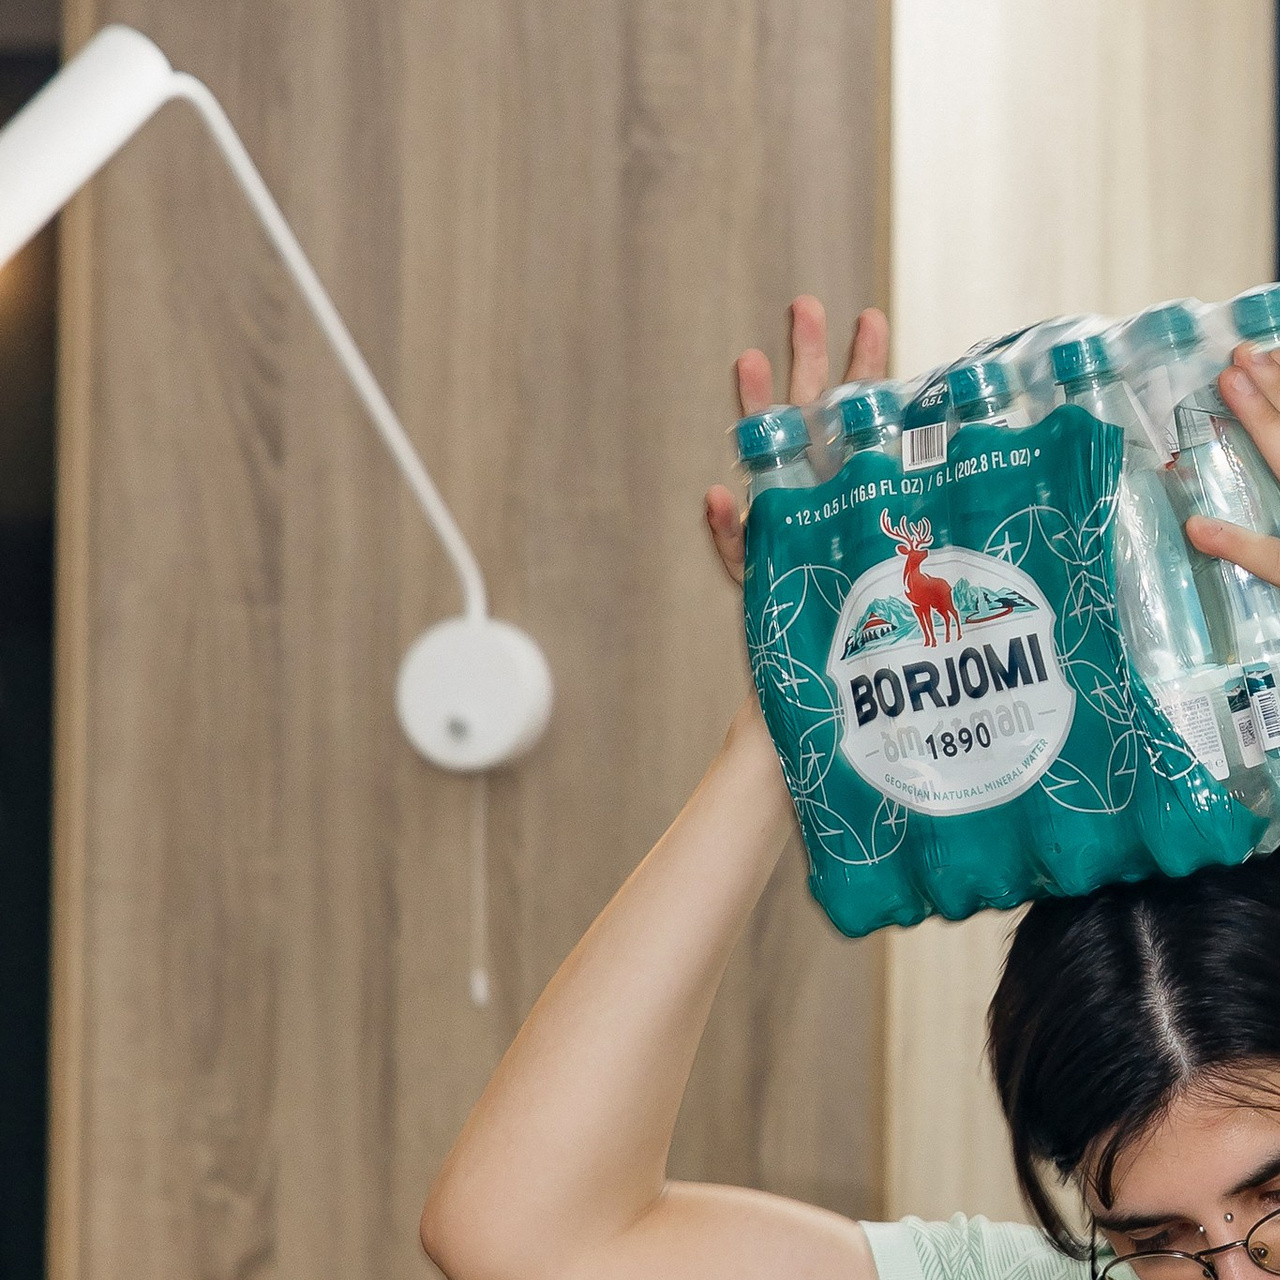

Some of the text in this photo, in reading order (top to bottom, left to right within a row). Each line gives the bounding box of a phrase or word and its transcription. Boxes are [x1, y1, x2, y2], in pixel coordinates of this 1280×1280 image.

[921, 394, 944, 408] 0.5 L
[796, 509, 811, 526] 12
[814, 510, 821, 522] x
[823, 498, 840, 519] 0.5
[842, 493, 848, 510] L
[850, 482, 877, 508] (16.9
[880, 479, 898, 496] FL
[901, 477, 924, 495] OZ)
[927, 474, 933, 492] /
[936, 470, 943, 487] 6
[946, 467, 953, 483] L
[955, 453, 988, 482] (202.8
[991, 451, 1007, 469] FL
[1010, 448, 1031, 467] OZ)
[850, 633, 1048, 727] BORJOMI
[885, 773, 930, 800] GEORGIAN
[933, 785, 984, 801] NATURAL
[984, 767, 1023, 792] MINERAL
[1021, 738, 1049, 769] WATER
[925, 722, 991, 760] 1890
